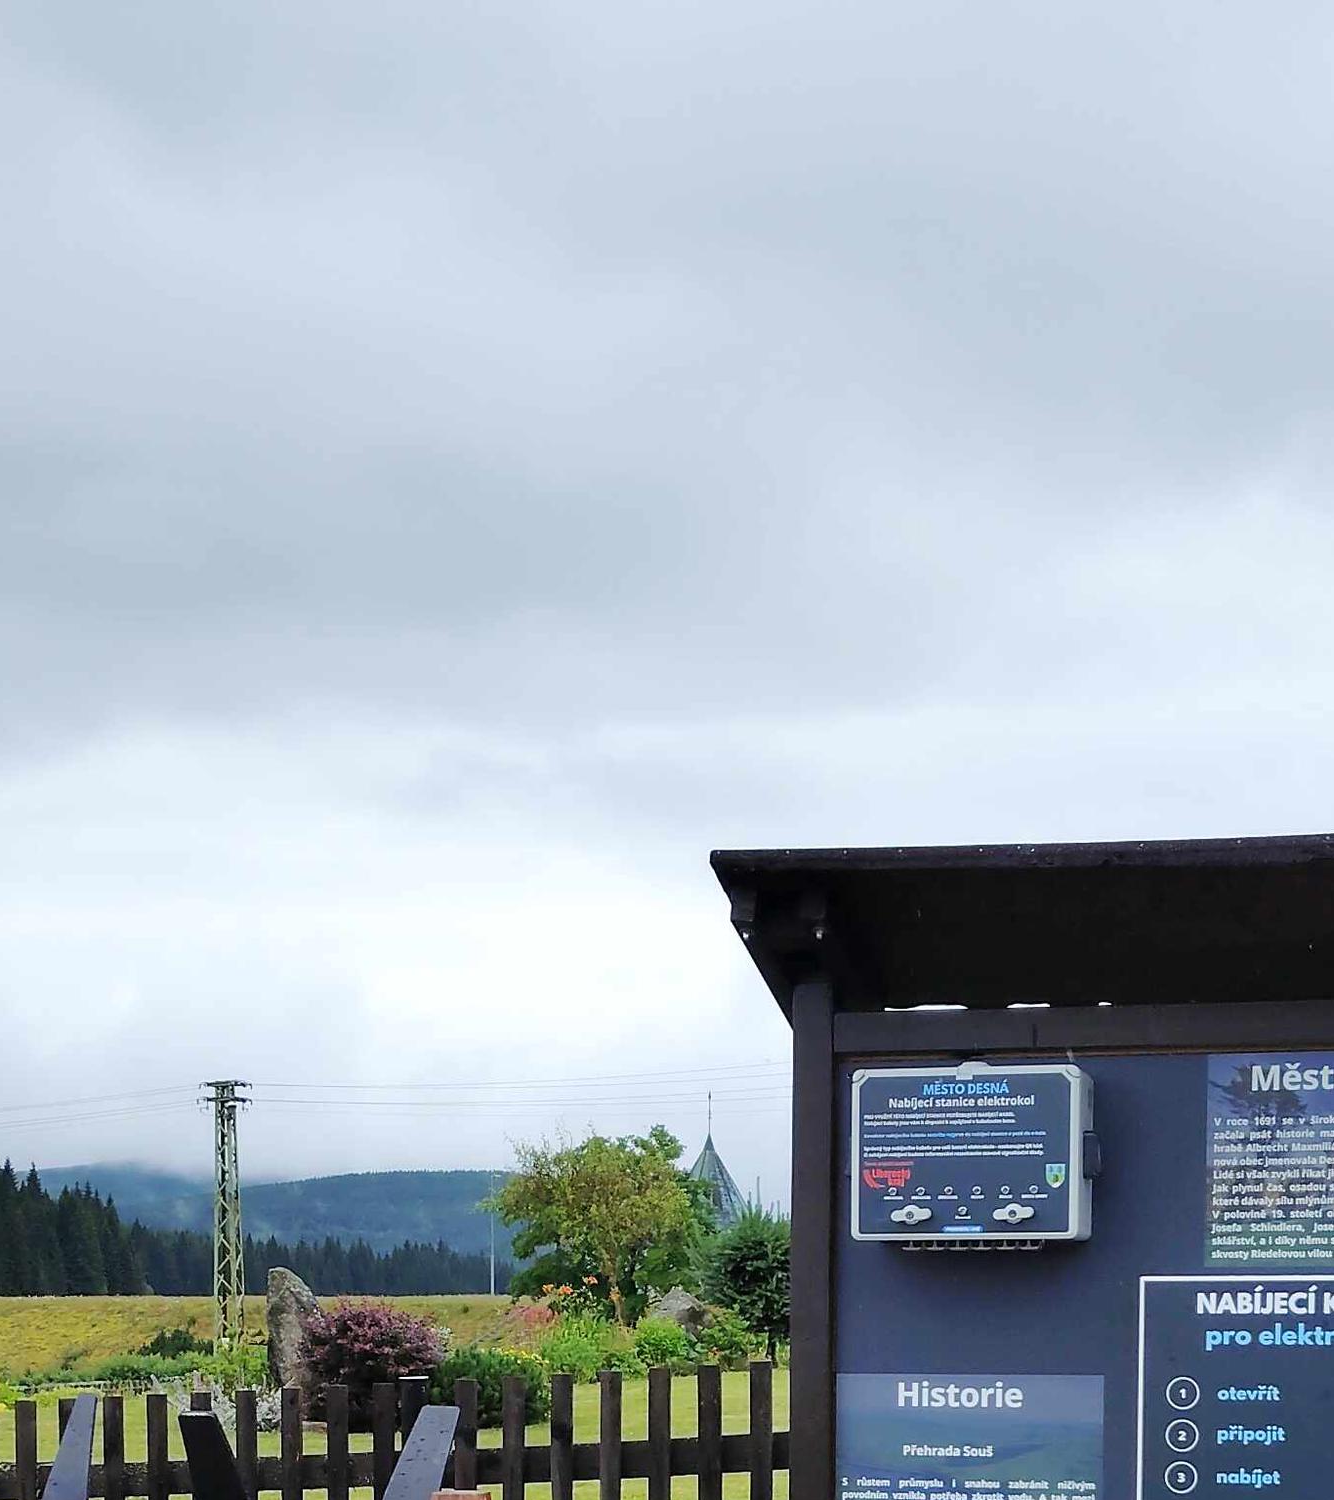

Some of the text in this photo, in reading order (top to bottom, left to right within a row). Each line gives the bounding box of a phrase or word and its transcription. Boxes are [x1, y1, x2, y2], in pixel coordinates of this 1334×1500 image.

[923, 1079, 1009, 1095] MĚSTO DESNÁ
[889, 1095, 1034, 1110] Nabíjecí stanice elektrokol
[1214, 1117, 1221, 1126] V
[1254, 1116, 1276, 1125] 1691
[1212, 1210, 1220, 1219] V
[1197, 1285, 1316, 1314] NABÍJECÍ
[1205, 1330, 1251, 1350] pro
[897, 1381, 1023, 1408] Historie
[1179, 1385, 1281, 1401] 1 otevřít
[1178, 1425, 1286, 1445] 2 připojit
[902, 1444, 994, 1457] Přehrada Souš
[1177, 1468, 1281, 1488] 3 nabíjet
